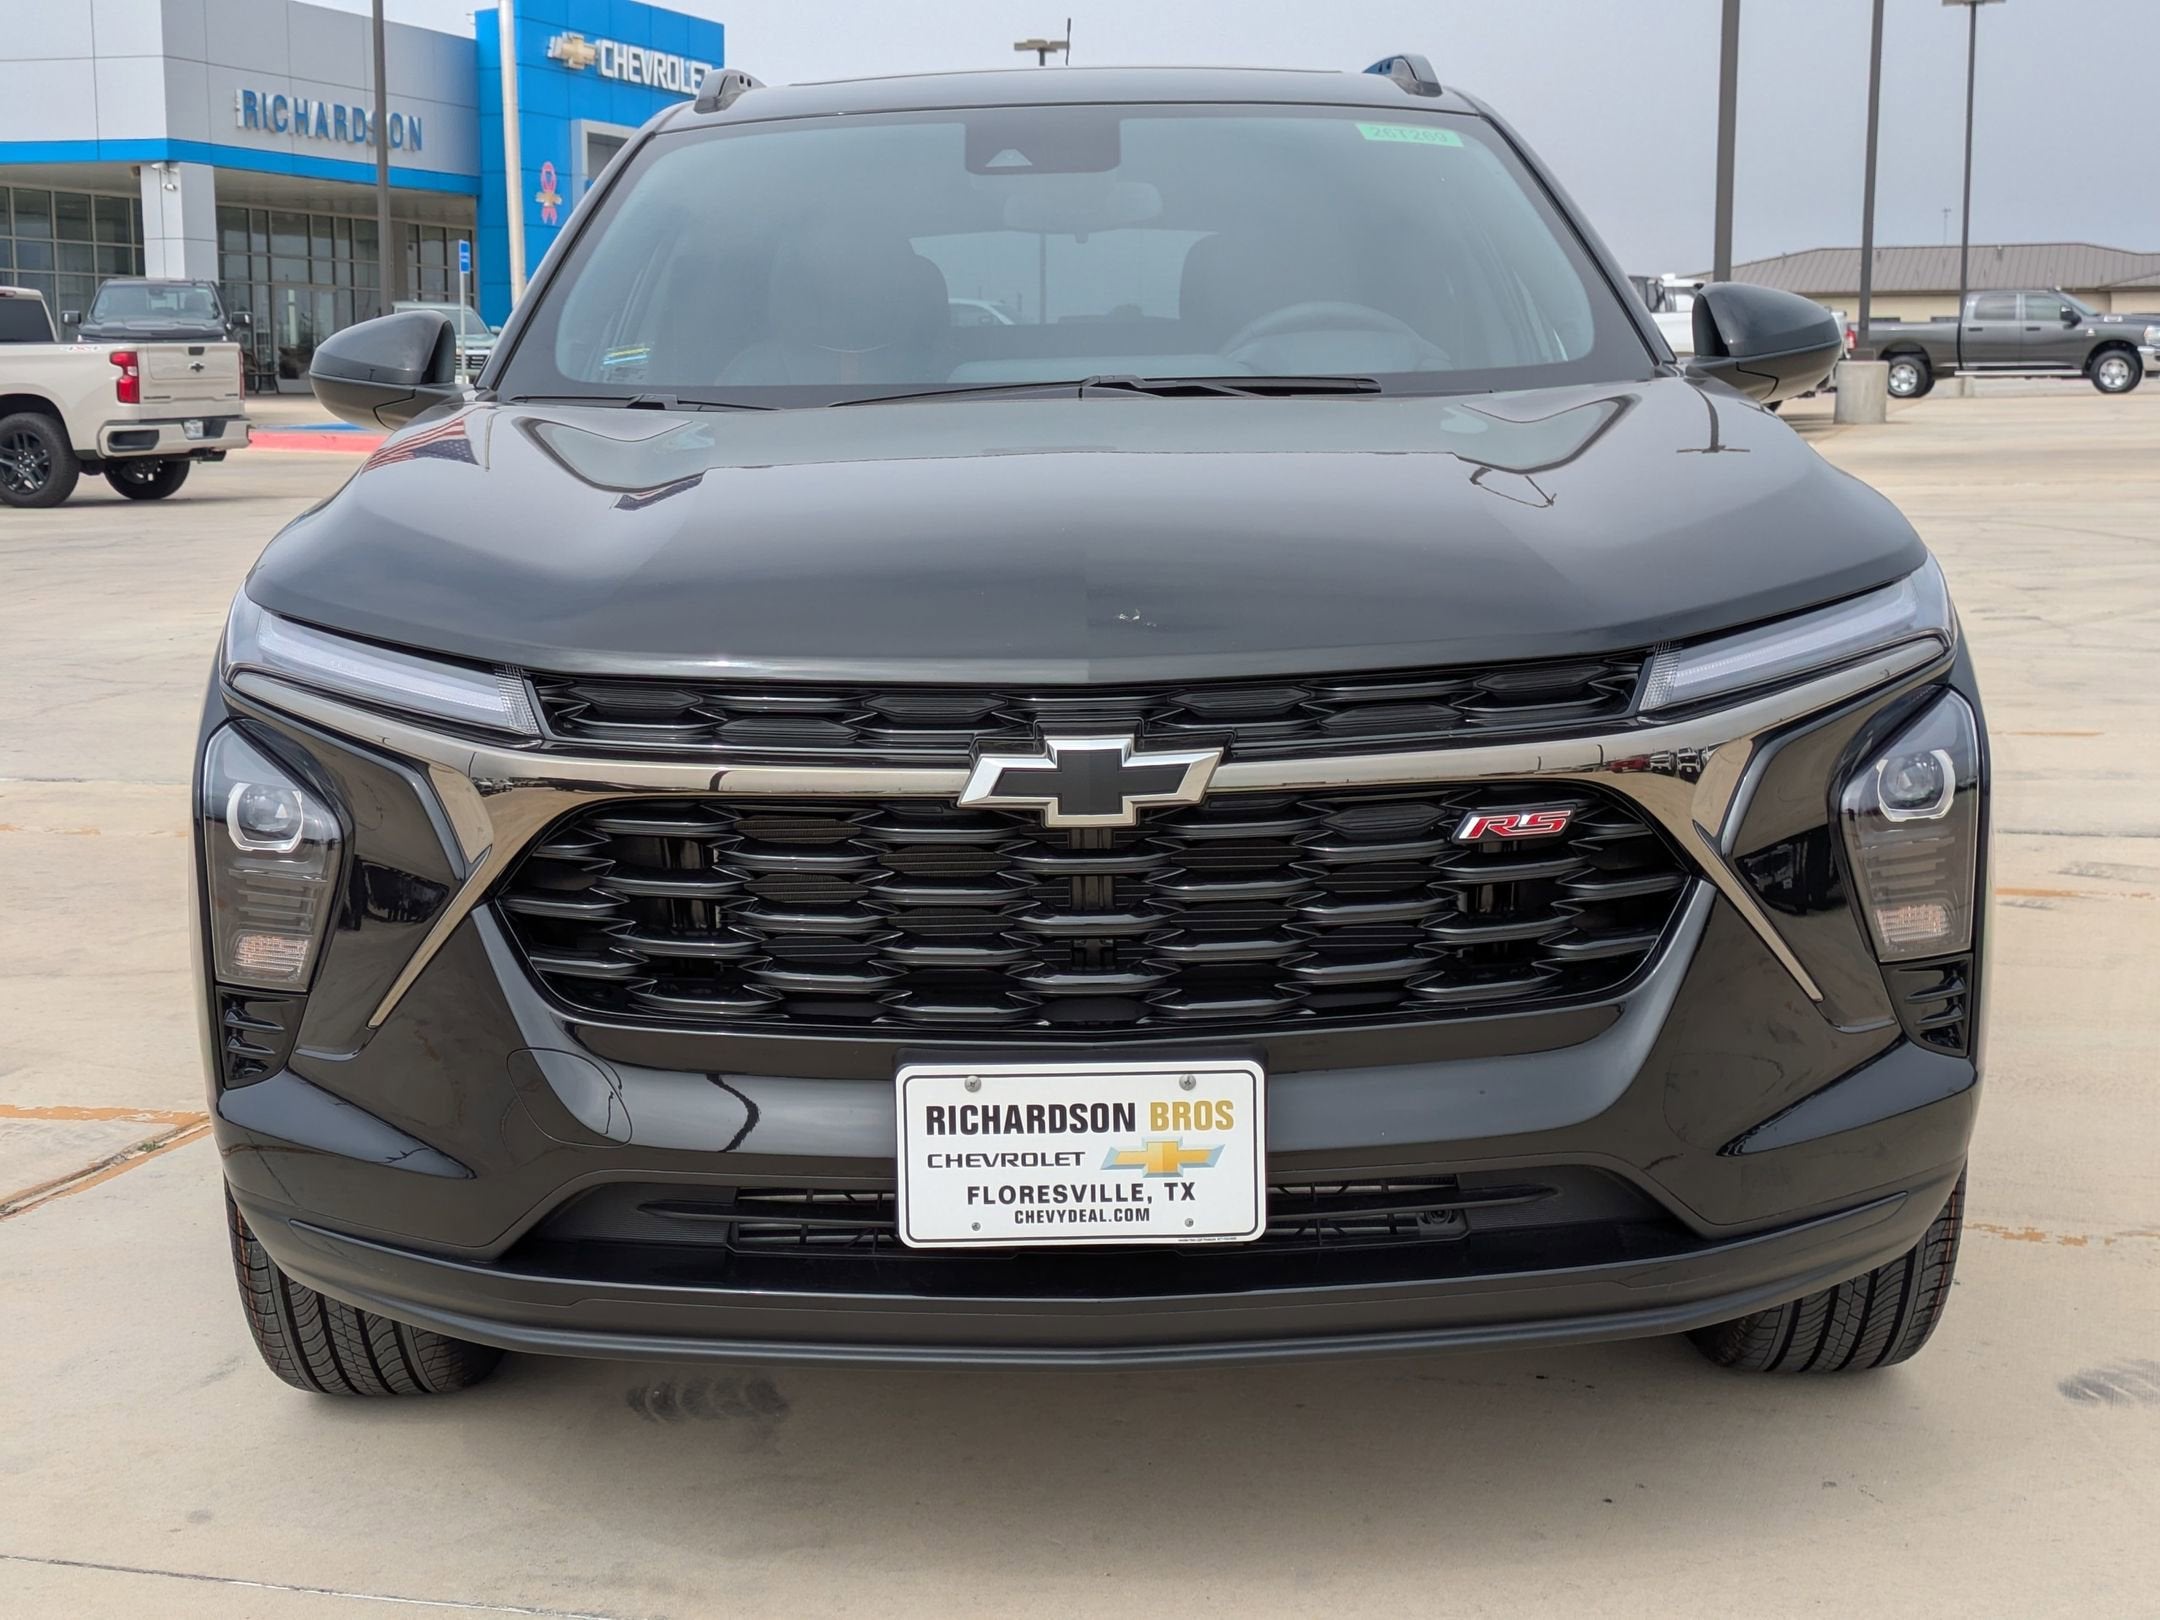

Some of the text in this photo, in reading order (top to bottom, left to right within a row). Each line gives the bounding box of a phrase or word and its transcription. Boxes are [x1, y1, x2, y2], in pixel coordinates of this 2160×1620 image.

[597, 39, 713, 96] CHEVROLE
[1458, 810, 1572, 839] RS
[926, 1100, 1235, 1136] RICHARDSON BROS
[927, 1151, 1086, 1169] CHEVROLET
[967, 1182, 1196, 1205] FLORESVILLE, TX
[1014, 1208, 1151, 1225] CHEVYDEAL.COM
